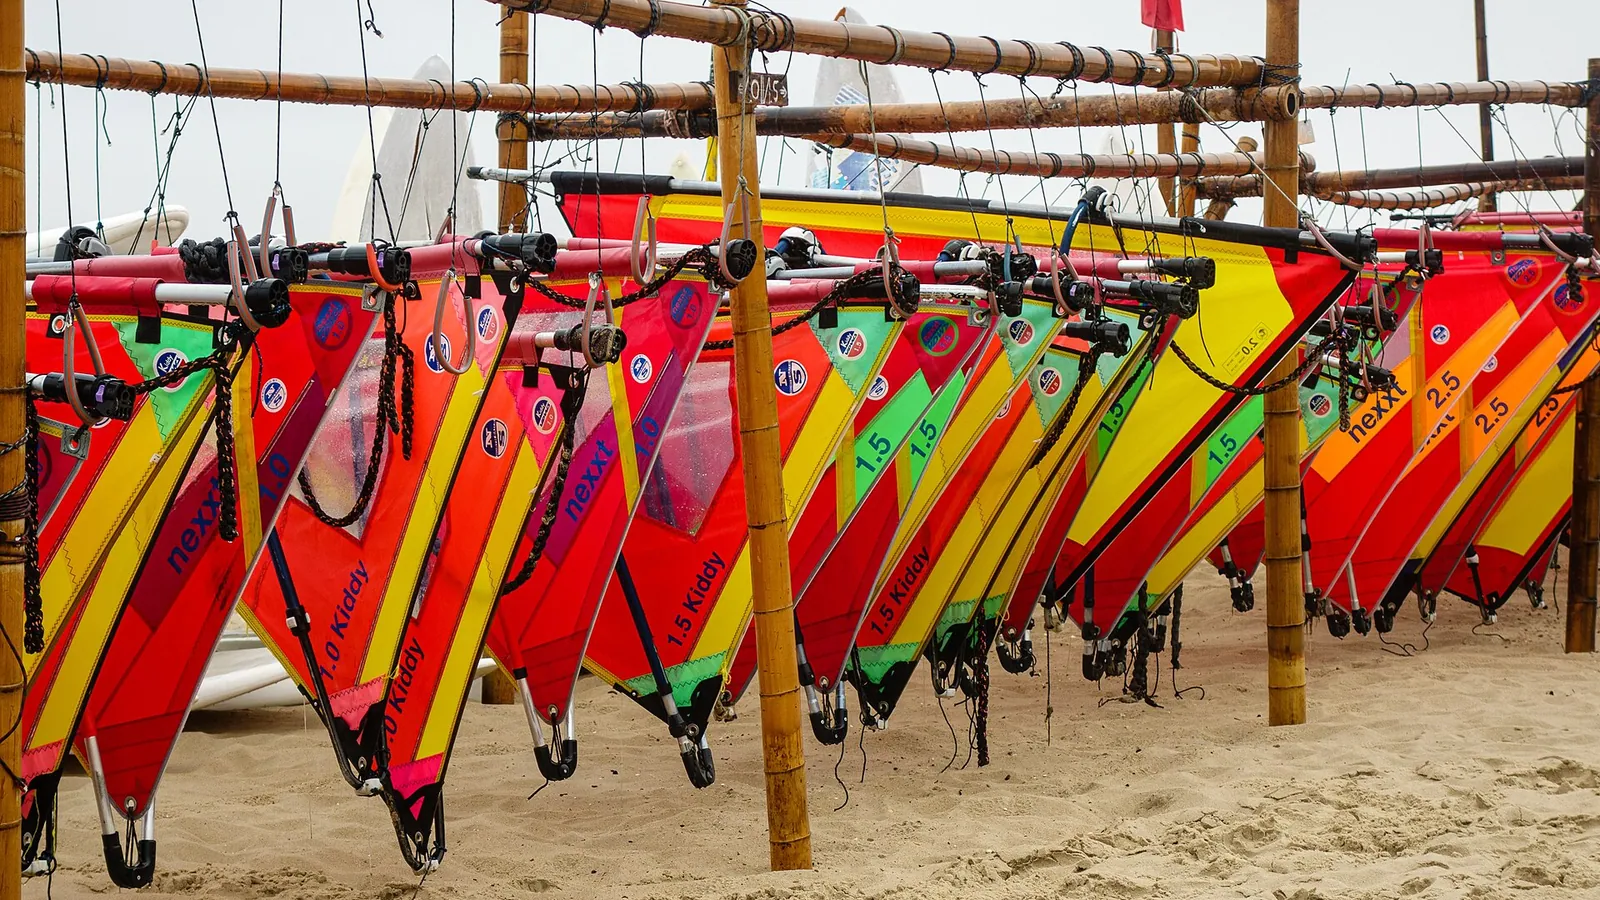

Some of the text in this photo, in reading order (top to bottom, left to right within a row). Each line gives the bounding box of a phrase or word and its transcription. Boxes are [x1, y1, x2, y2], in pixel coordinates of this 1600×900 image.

[158, 354, 174, 373] Kiddy
[1427, 370, 1460, 409] 2.5
[1099, 402, 1124, 434] 1.5
[1348, 381, 1407, 443] nexxt
[1475, 397, 1509, 434] 2.5
[1536, 397, 1559, 428] 2.5
[636, 416, 659, 457] 1.0
[856, 432, 891, 473] 1.5
[911, 418, 937, 458] 1.5
[1209, 432, 1237, 465] 1.5
[260, 452, 291, 503] 1.0
[565, 439, 614, 523] nexxt
[667, 550, 726, 647] 1.5 Kiddy
[870, 545, 930, 636] 1.5 Kiddy
[319, 559, 369, 681] 1.0 Kiddy
[385, 636, 425, 743] .0 Kiddy
